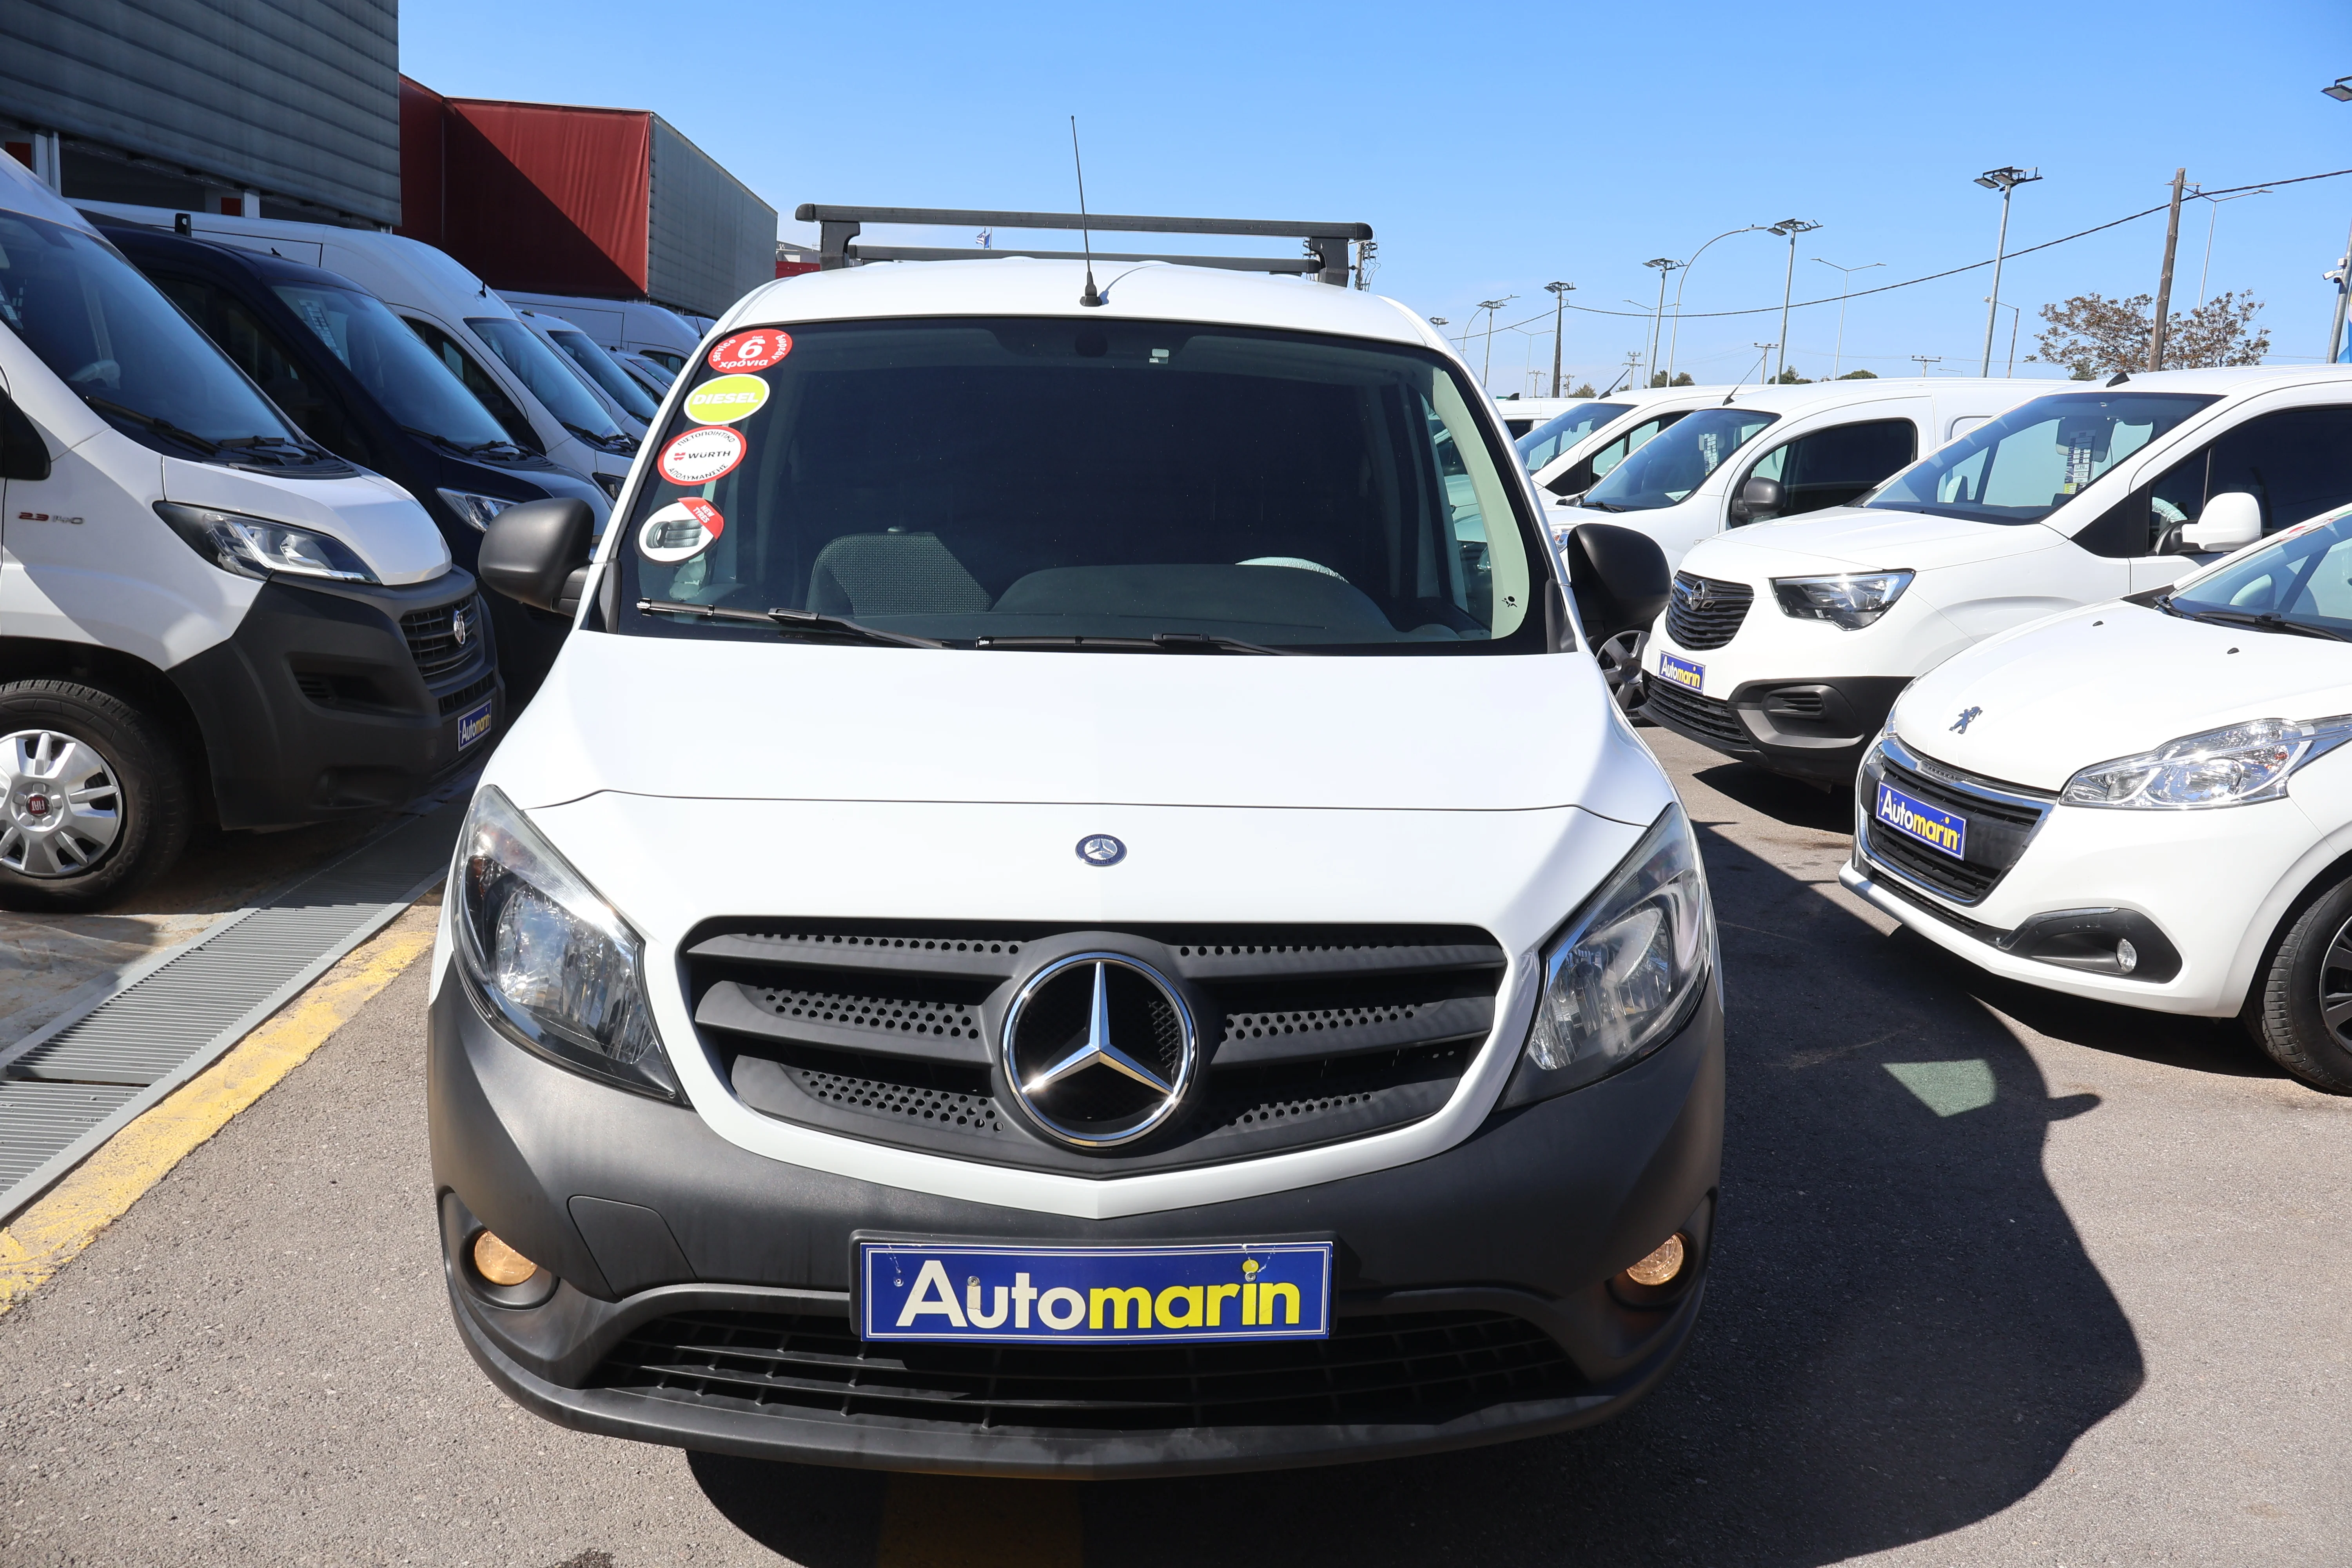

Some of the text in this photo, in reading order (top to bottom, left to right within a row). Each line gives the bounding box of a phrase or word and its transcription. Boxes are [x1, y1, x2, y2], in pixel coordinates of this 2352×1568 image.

[713, 339, 736, 362] service
[737, 339, 766, 359] 6
[718, 359, 769, 369] χρόνια
[692, 392, 759, 405] DIESEL
[677, 431, 735, 446] ΠΙΣΤΟΠΟΙΗΤΙΚΟ
[668, 463, 729, 480] ΑΠΟΛΥΜΑΝΣΗΣ
[693, 506, 710, 523] TYRES
[700, 505, 715, 517] NEW
[1661, 656, 1700, 688] Automarin
[461, 707, 490, 744] Automarin
[32, 800, 45, 811] FIAT
[1881, 789, 1958, 851] Automarin
[896, 1259, 1300, 1329] Automarin
